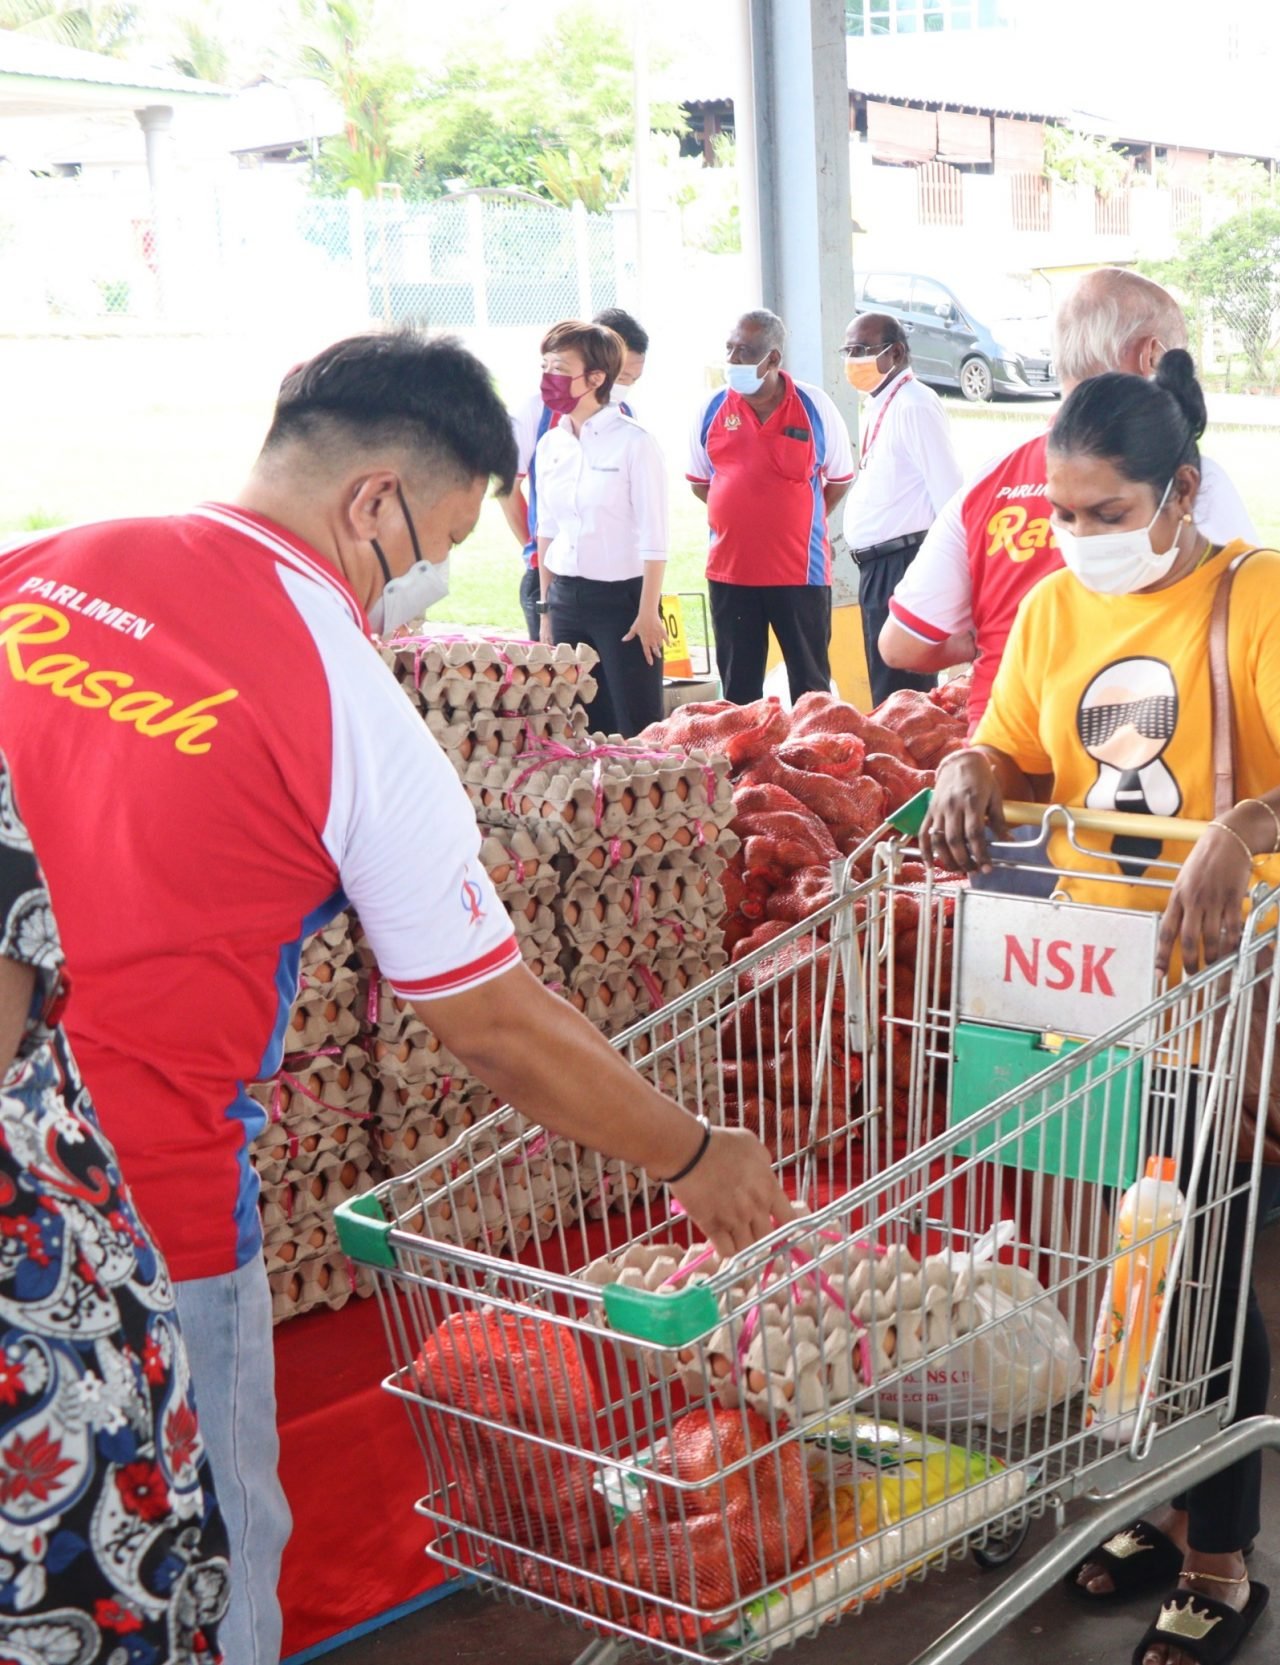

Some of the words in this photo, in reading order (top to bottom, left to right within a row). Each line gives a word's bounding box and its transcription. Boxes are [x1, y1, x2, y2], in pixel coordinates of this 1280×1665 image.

[18, 576, 155, 641] PARLIMEN
[0, 602, 240, 756] Rasah
[1003, 934, 1118, 998] NSK
